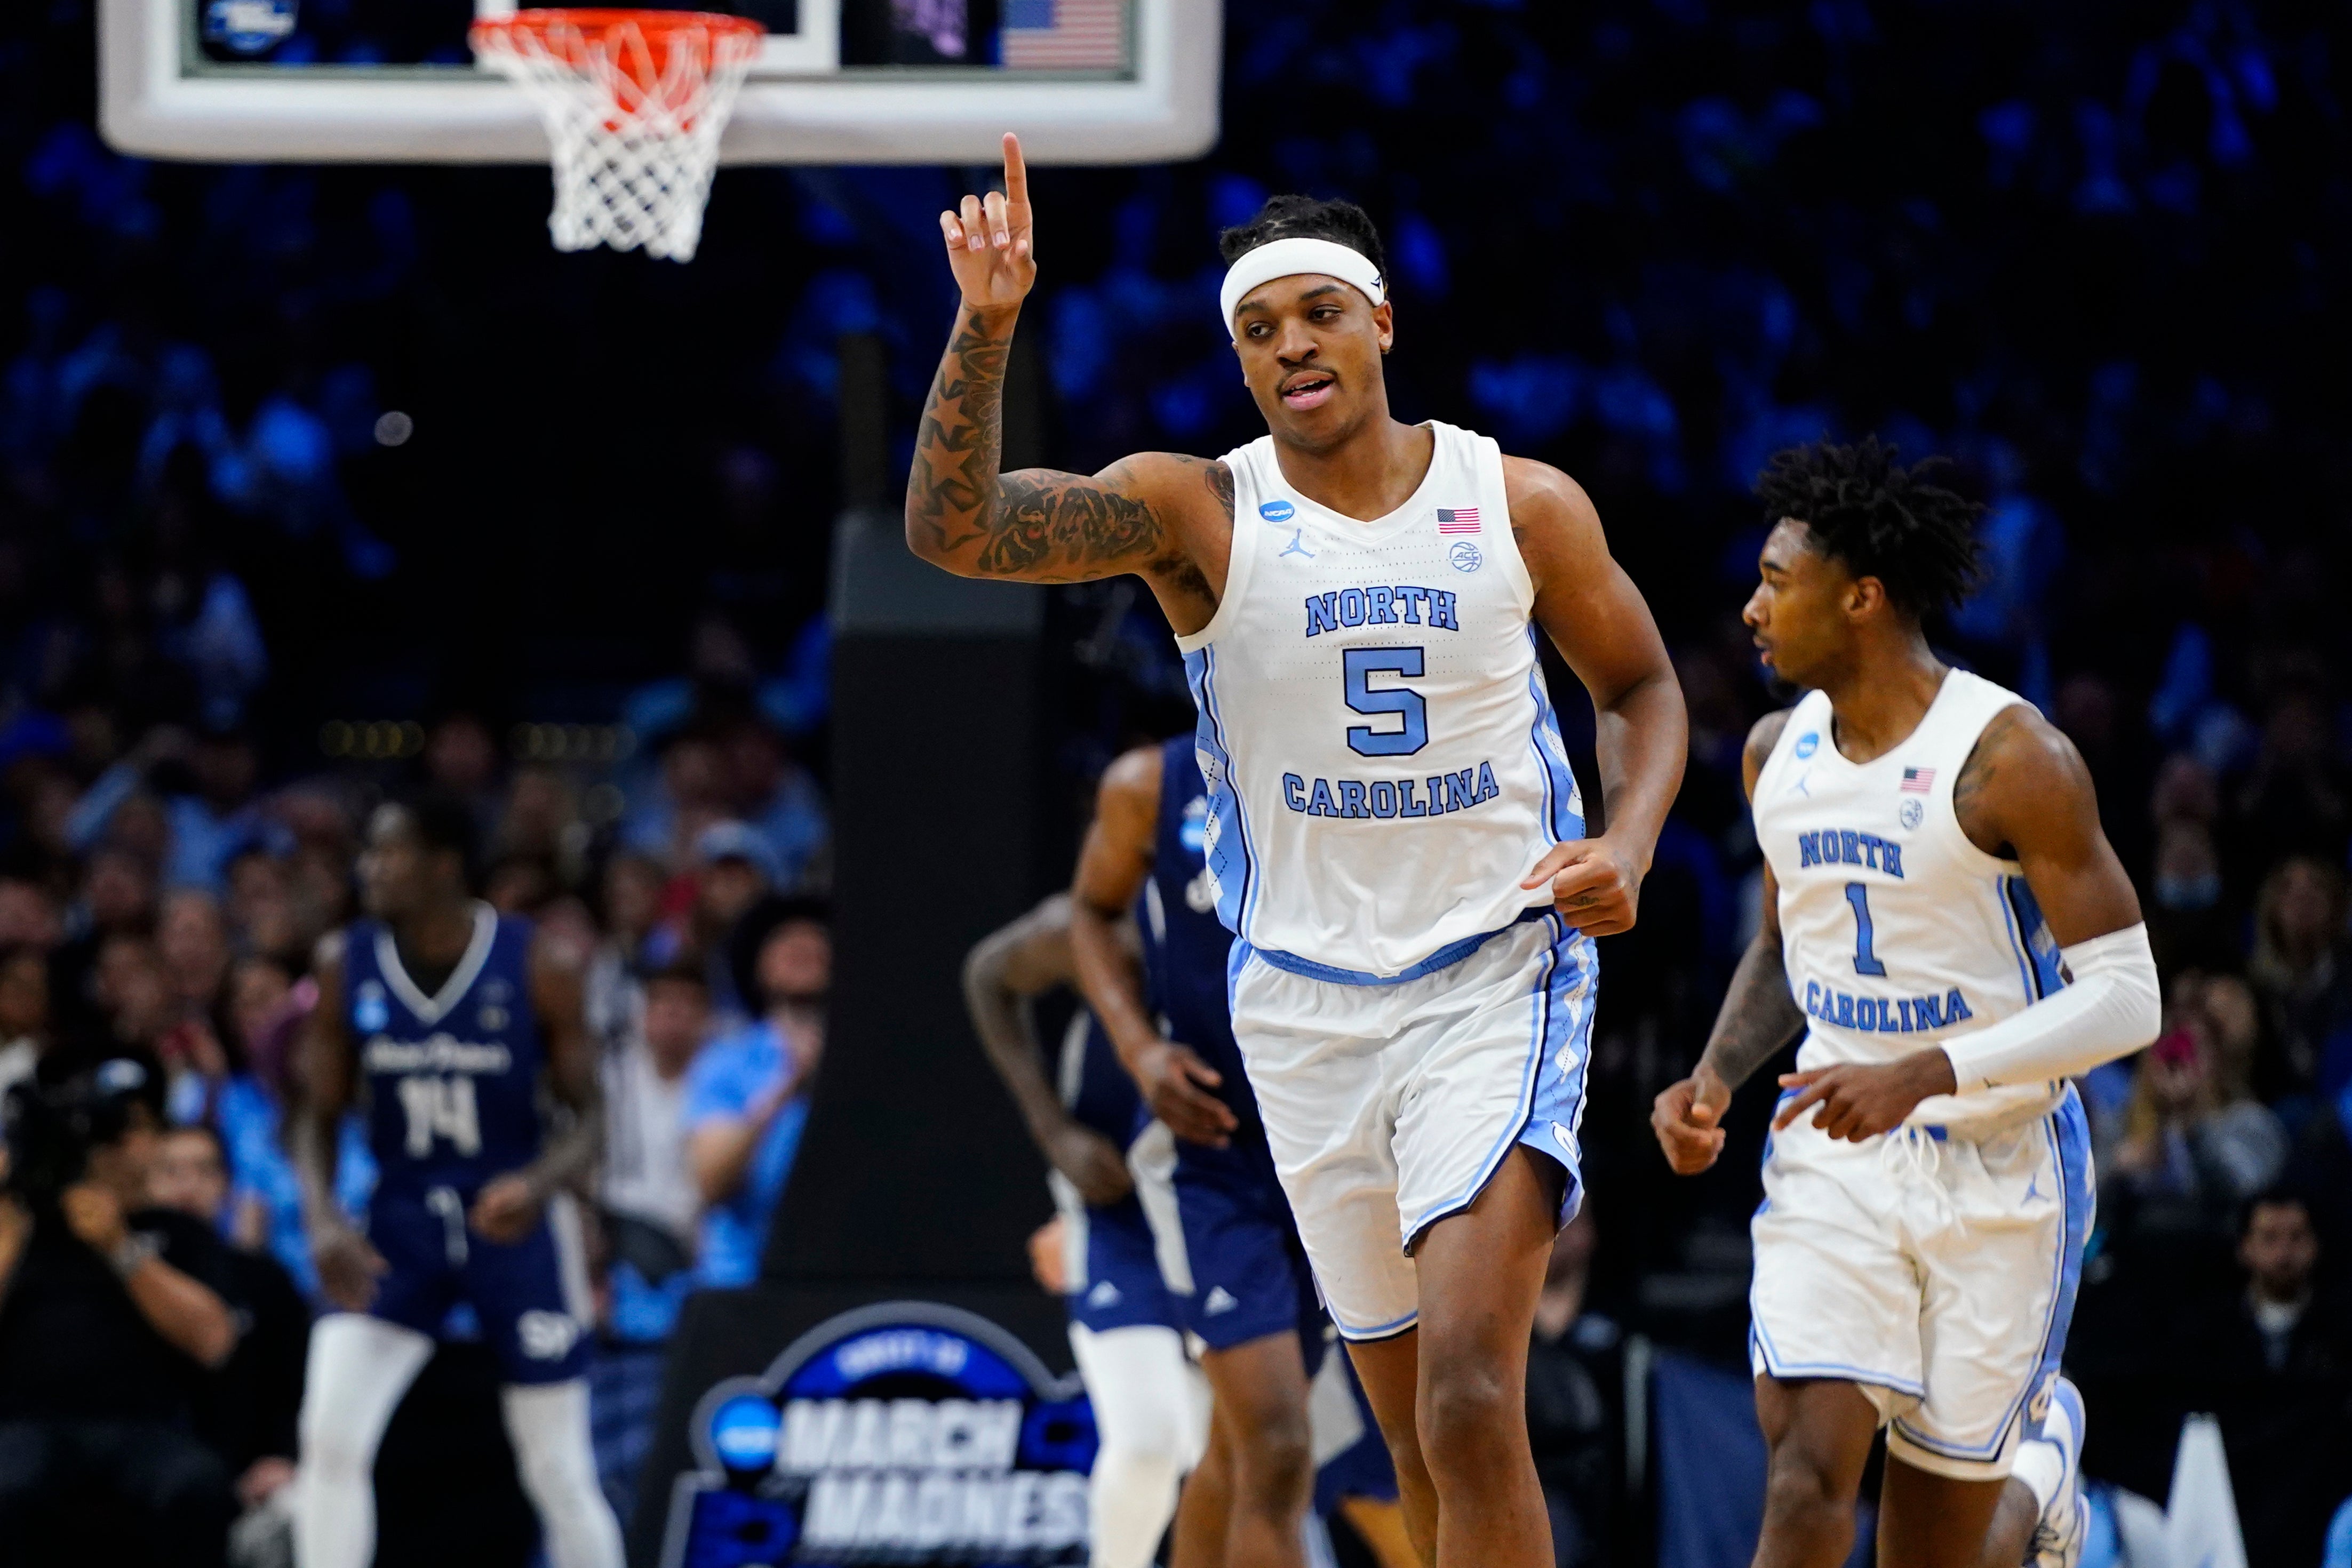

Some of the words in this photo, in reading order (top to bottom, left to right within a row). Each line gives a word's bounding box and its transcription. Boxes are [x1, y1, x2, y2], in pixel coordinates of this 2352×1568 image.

[1264, 508, 1291, 517] NCAA
[1305, 586, 1459, 637] NORTH
[1342, 646, 1429, 757] 5
[1282, 761, 1500, 819] CAROLINA
[1798, 827, 1904, 879] NORTH
[1845, 881, 1887, 978] 1
[1805, 978, 1974, 1033] CAROLINA
[398, 1074, 483, 1158] 14
[777, 1396, 1025, 1476] MARCH
[799, 1468, 1093, 1551] MADNES
